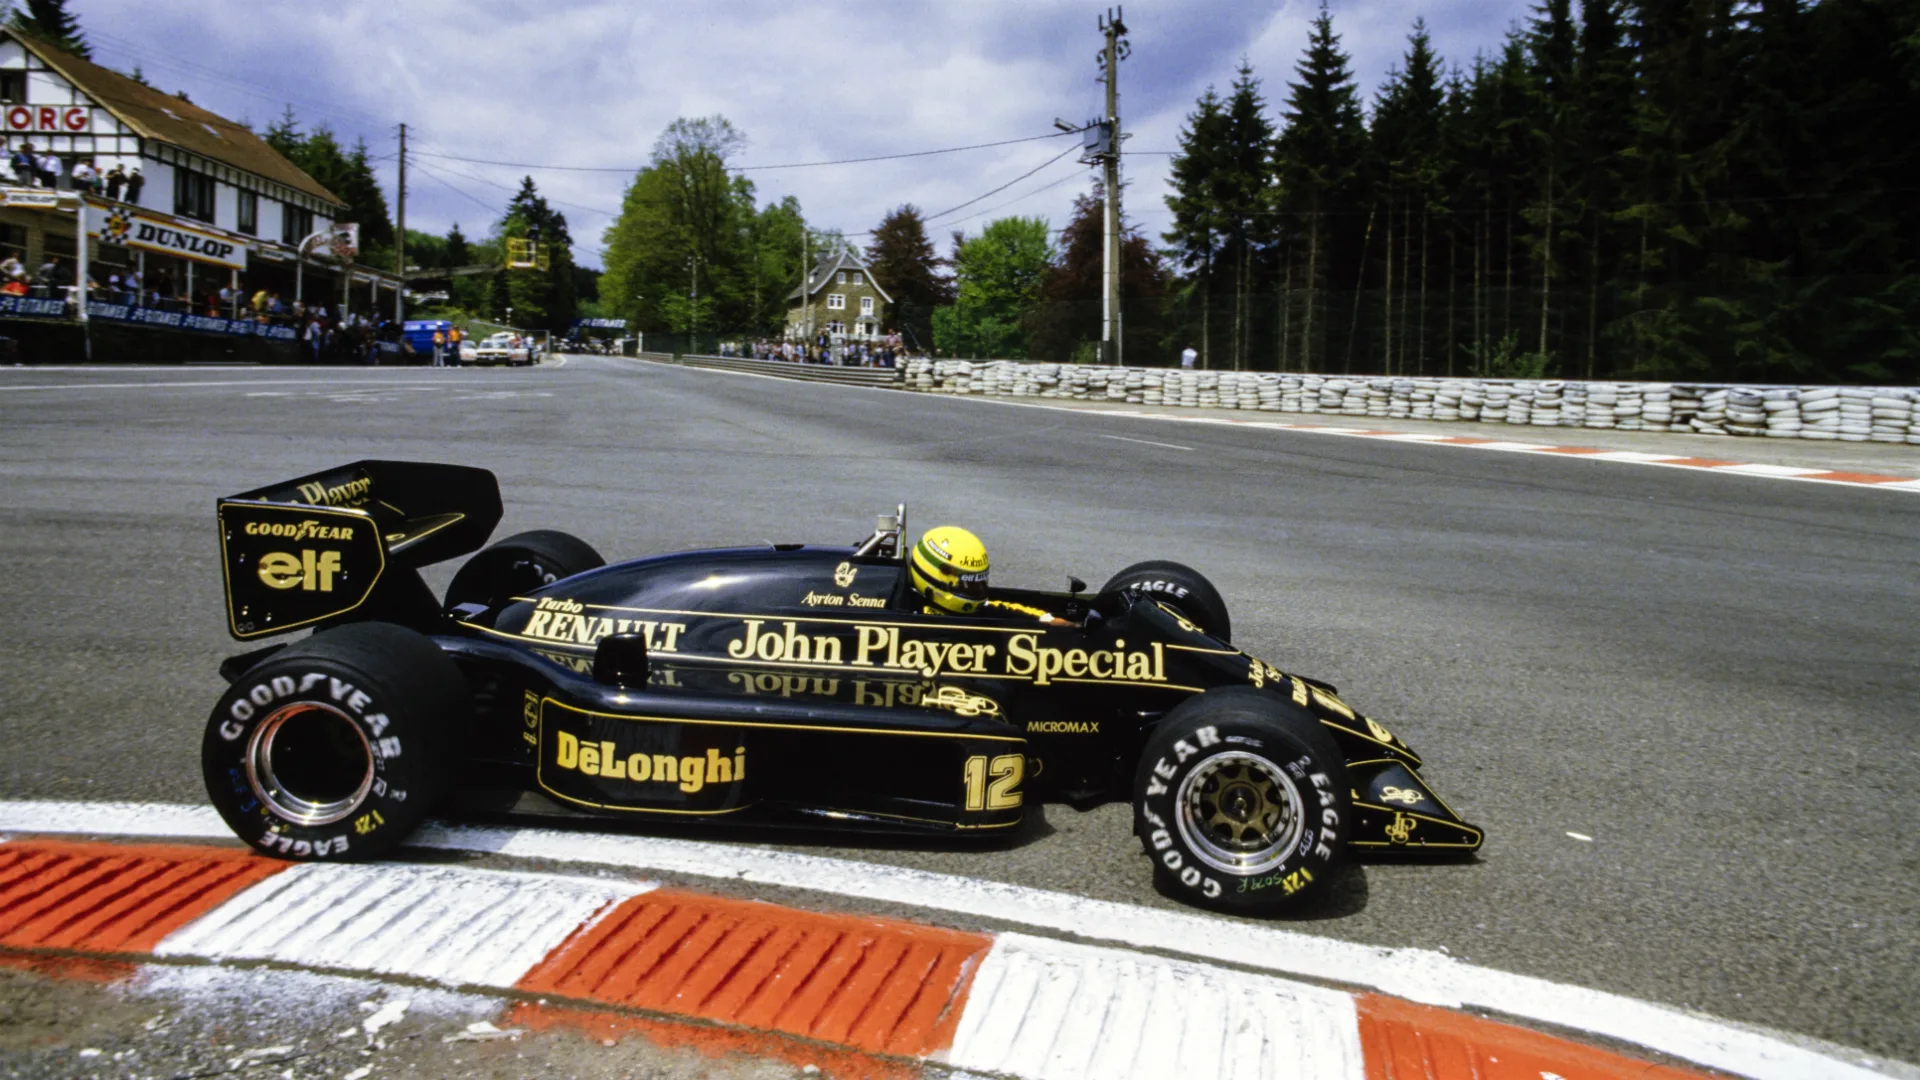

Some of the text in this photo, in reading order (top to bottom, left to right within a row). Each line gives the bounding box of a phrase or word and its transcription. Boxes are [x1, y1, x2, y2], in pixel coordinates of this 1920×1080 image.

[137, 222, 234, 259] DUNLOP
[257, 549, 341, 592] elf
[537, 597, 584, 613] Turbo
[801, 590, 887, 608] Ayrton Senna
[1130, 580, 1190, 599] EAGLE
[728, 619, 1168, 685] John Player Special
[1027, 721, 1100, 733] MICROMAX
[963, 753, 1025, 811] 12
[1309, 771, 1340, 862] EAGLE
[258, 829, 349, 856] EAGLE
